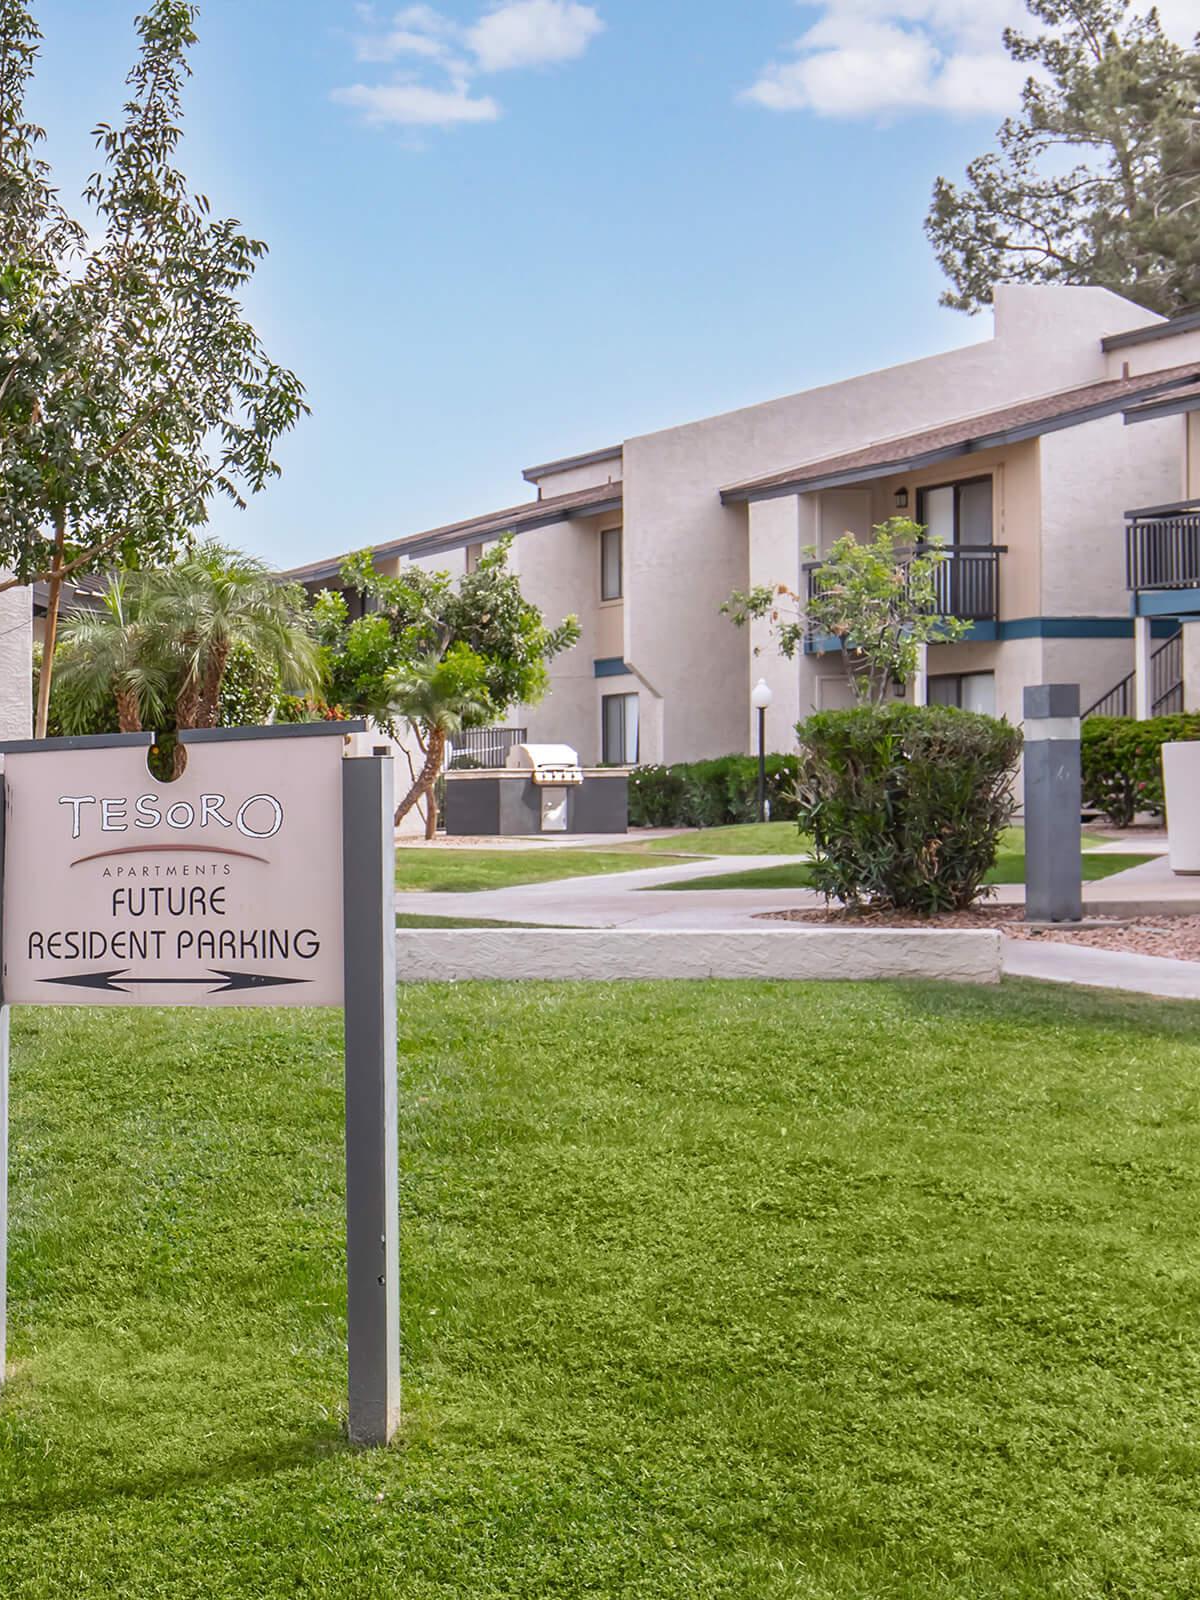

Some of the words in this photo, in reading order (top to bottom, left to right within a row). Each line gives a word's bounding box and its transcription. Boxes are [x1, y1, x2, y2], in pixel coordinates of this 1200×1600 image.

[103, 864, 232, 878] APARTMENTS
[112, 886, 226, 917] FUTURE
[28, 930, 166, 960] RESIDENT
[177, 929, 321, 960] PARKING
